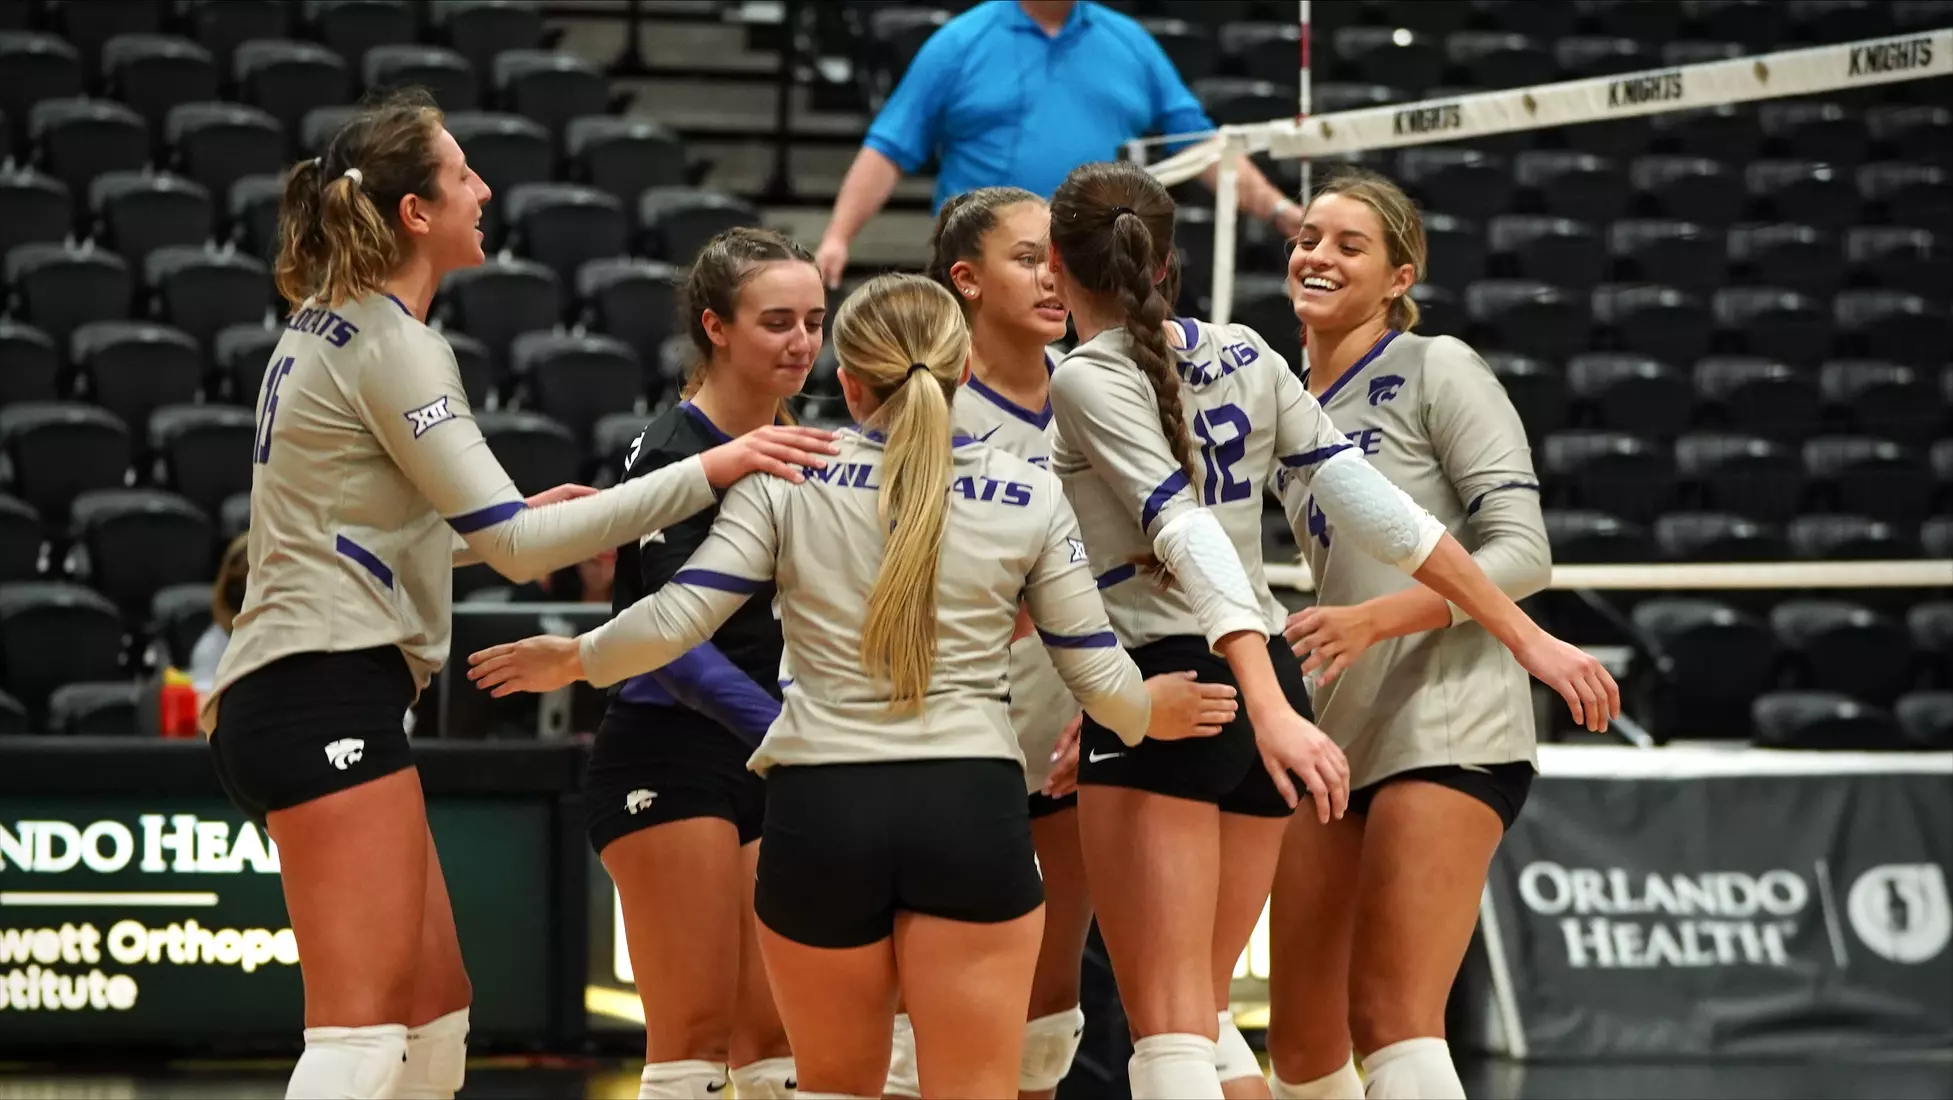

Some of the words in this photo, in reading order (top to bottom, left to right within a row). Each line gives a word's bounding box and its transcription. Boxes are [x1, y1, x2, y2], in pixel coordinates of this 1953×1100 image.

[1848, 38, 1933, 77] KNIGHTS
[1608, 72, 1683, 107] KNIGHTS
[1393, 104, 1462, 136] KNIGHTS
[254, 356, 296, 464] 15
[404, 395, 457, 439] XII
[1194, 403, 1252, 506] 12
[1519, 860, 1809, 917] ORLANDO
[1560, 916, 1790, 968] HEALTH
